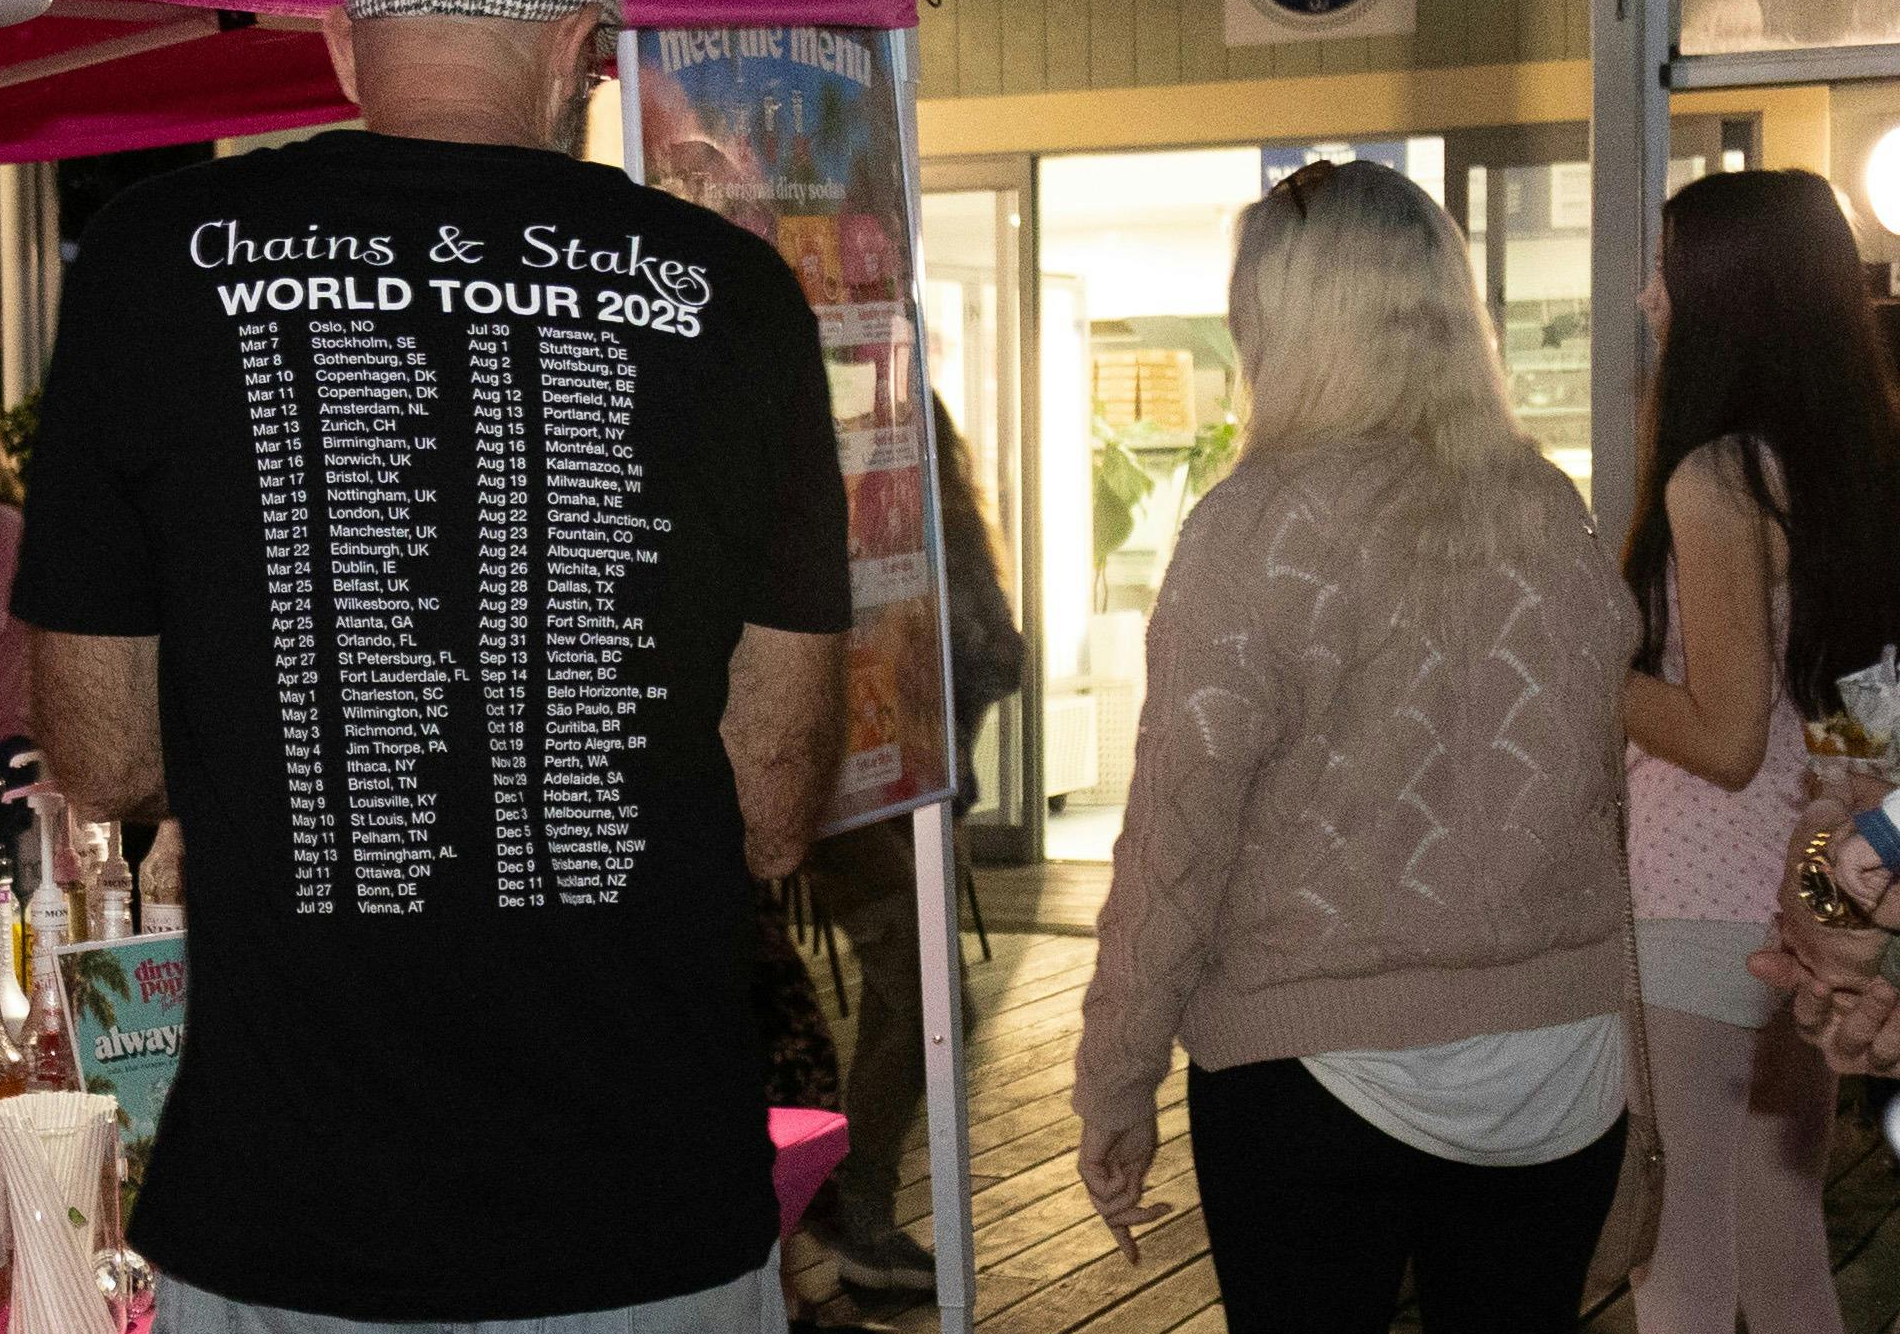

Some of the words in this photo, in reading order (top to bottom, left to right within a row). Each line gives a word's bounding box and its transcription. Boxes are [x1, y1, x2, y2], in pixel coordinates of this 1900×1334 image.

[791, 29, 871, 87] menu
[191, 220, 396, 268] Chains
[428, 225, 485, 263] &
[522, 224, 711, 306] Stakes
[218, 277, 413, 315] WORLD
[429, 279, 581, 318] TOUR
[598, 290, 702, 339] 2025
[239, 325, 265, 336] Mar
[269, 322, 278, 333] 6
[309, 321, 346, 333] Oslo,
[351, 321, 374, 332] NO
[467, 324, 488, 335] Jul
[492, 325, 510, 336] 30
[538, 327, 596, 342] Warsaw,
[601, 331, 619, 344] PL
[243, 357, 269, 369] Mar
[273, 354, 282, 365] 8
[314, 353, 402, 367] Gothenburg,
[407, 353, 426, 365] SE
[250, 407, 276, 419] Mar
[281, 404, 297, 415] 12
[320, 403, 404, 415] Amsterdam,
[408, 403, 429, 415] NL
[476, 439, 504, 454] Aug
[509, 440, 525, 452] 16
[546, 441, 608, 457] Montréal,
[612, 445, 633, 458] QC
[262, 493, 286, 505] Mar
[291, 490, 306, 502] 19
[327, 488, 410, 503] Nottingham,
[415, 489, 436, 502] UK
[478, 509, 506, 524] Aug
[510, 509, 527, 521] 22
[548, 509, 589, 523] Grand
[593, 511, 649, 530] Junction,
[653, 518, 671, 532] CO
[479, 545, 506, 560] Aug
[510, 545, 527, 557] 24
[547, 545, 633, 562] Albuquerque,
[637, 549, 658, 563] NM
[280, 691, 305, 705] May
[310, 690, 314, 701] 1
[342, 688, 418, 701] Charleston,
[423, 687, 444, 700] SC
[486, 704, 504, 716] Oct
[509, 703, 524, 715] 17
[547, 703, 572, 716] São
[576, 703, 613, 715] Paulo,
[617, 702, 636, 714] BR
[495, 791, 517, 803] Dec
[518, 792, 523, 801] 1
[544, 790, 591, 803] Hobart,
[596, 789, 620, 801] TAS
[297, 902, 315, 913] Jul
[318, 901, 333, 913] 29
[358, 901, 404, 914] Vienna,
[408, 900, 424, 912] AT
[95, 1025, 183, 1061] alway
